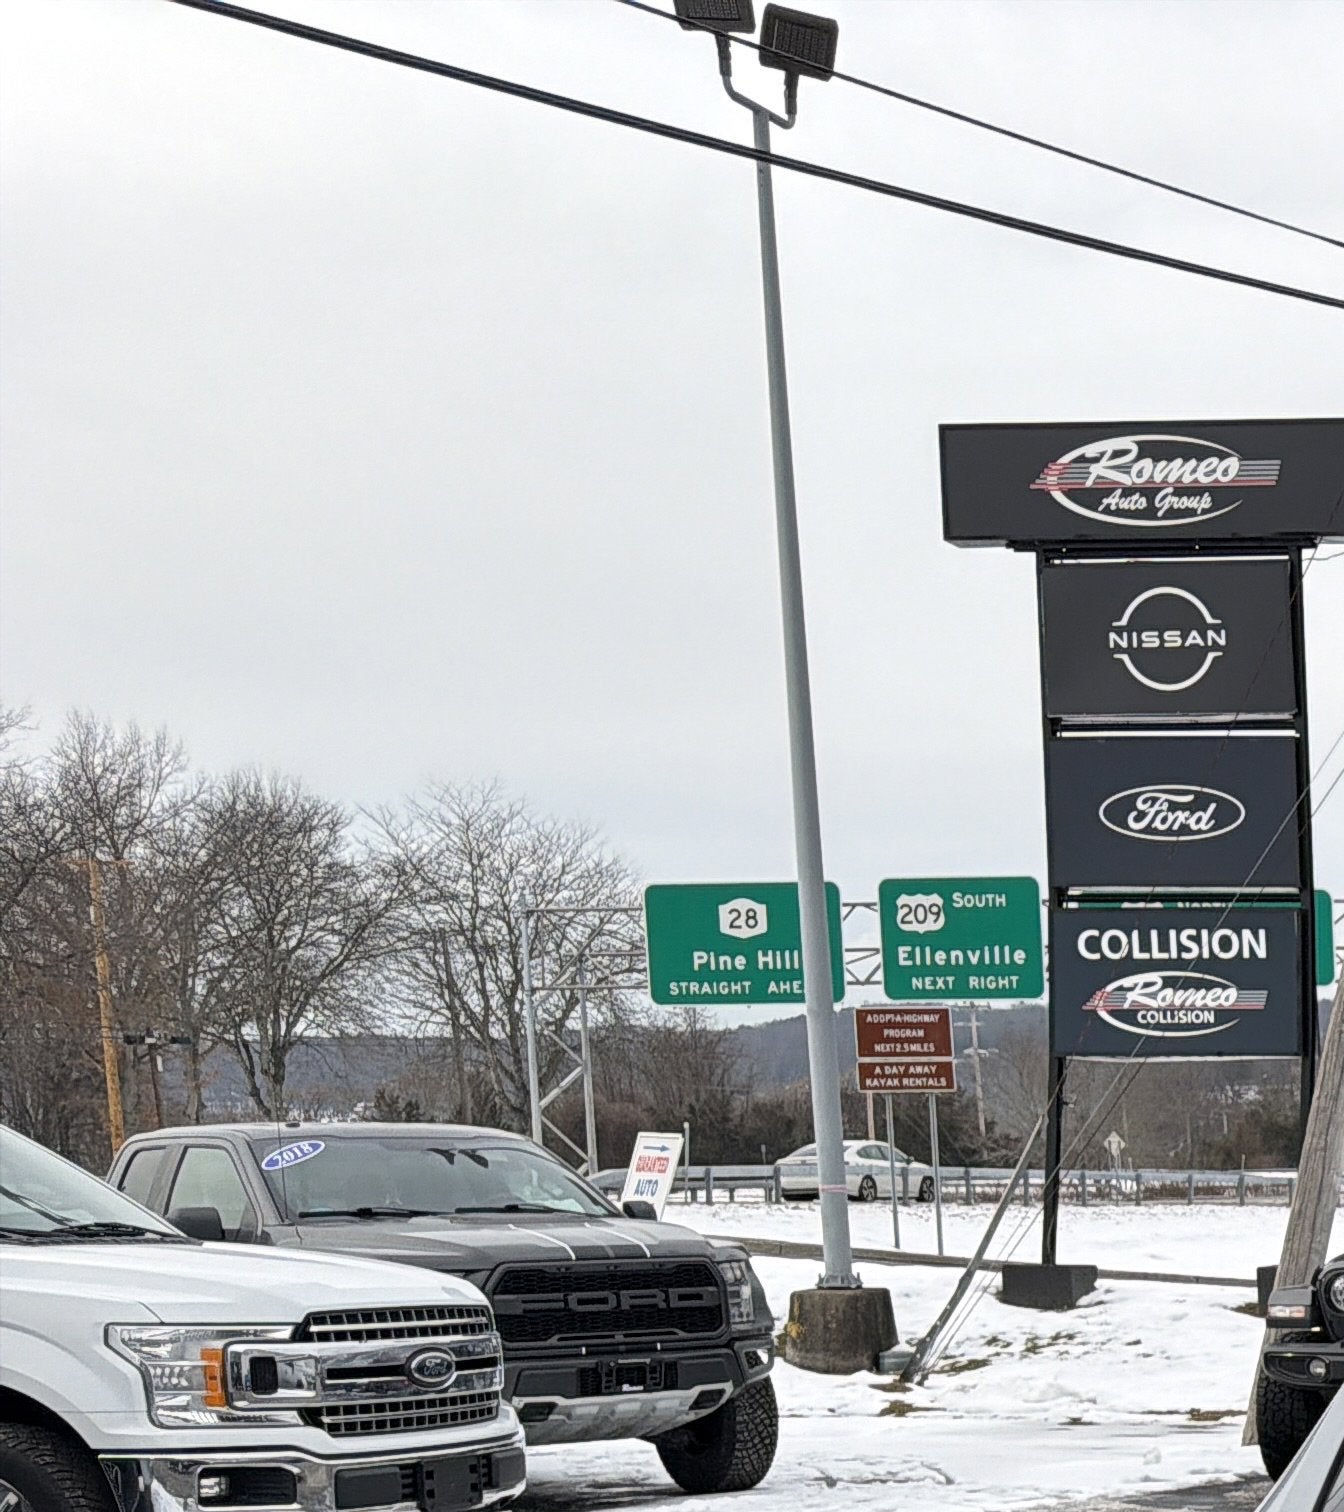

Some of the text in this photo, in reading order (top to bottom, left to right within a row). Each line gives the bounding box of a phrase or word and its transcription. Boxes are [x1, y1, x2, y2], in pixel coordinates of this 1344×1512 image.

[1083, 440, 1240, 487] Romeo
[1098, 487, 1212, 517] Auto Group
[1109, 629, 1226, 649] NISSAN
[1127, 792, 1217, 831] Ford
[952, 892, 1006, 908] SOUTH
[728, 908, 758, 929] 28
[900, 903, 941, 924] 209
[1077, 928, 1267, 960] COLLISION
[693, 950, 800, 971] Pine Hill
[898, 945, 1026, 966] Ellenville
[669, 980, 806, 996] STRAIGHT AHE
[912, 975, 1019, 990] NEXT RIGHT
[1122, 975, 1238, 1009] Romeo
[1137, 1010, 1215, 1024] COLLISION
[883, 1029, 925, 1038] PROGRAM
[874, 1043, 895, 1053] NEXT
[910, 1042, 935, 1053] MILES
[874, 1065, 937, 1075] A DAY AWAY
[866, 1077, 947, 1088] KAYAK RENTALS
[273, 1143, 313, 1165] 2018
[634, 1179, 659, 1197] AUTO
[493, 1287, 722, 1315] FORD
